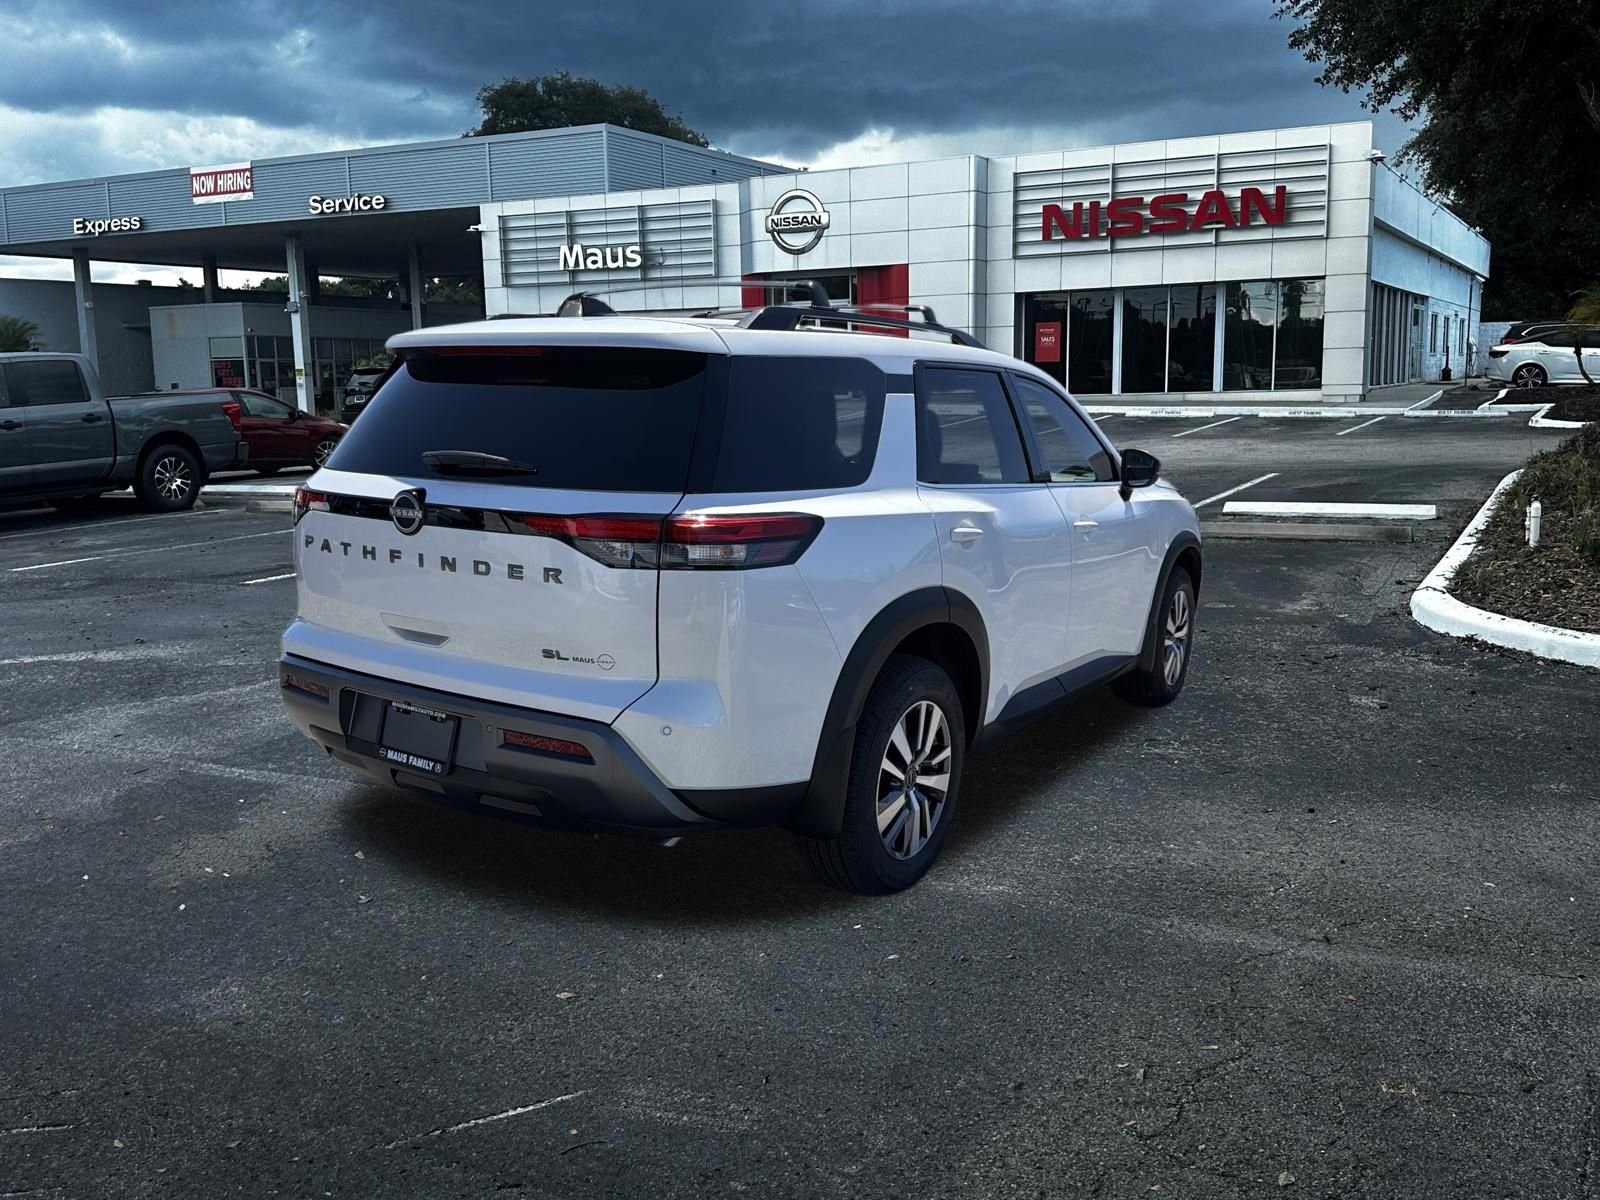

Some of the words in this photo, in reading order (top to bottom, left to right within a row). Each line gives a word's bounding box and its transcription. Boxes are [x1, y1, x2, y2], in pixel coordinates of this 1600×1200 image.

[192, 173, 216, 194] NOW
[217, 169, 251, 191] HIRING
[308, 193, 387, 216] Service
[1041, 184, 1287, 242] NISSAN
[72, 213, 142, 237] Express
[770, 214, 822, 229] NISSAN
[558, 244, 643, 271] Maus
[305, 535, 563, 584] PATHFINDER
[541, 648, 570, 661] SL
[572, 656, 596, 664] MAUS
[391, 701, 446, 718] MAUSFAMILYAUTO.COM
[387, 750, 408, 763] MAUS
[409, 756, 434, 771] FAMILY
